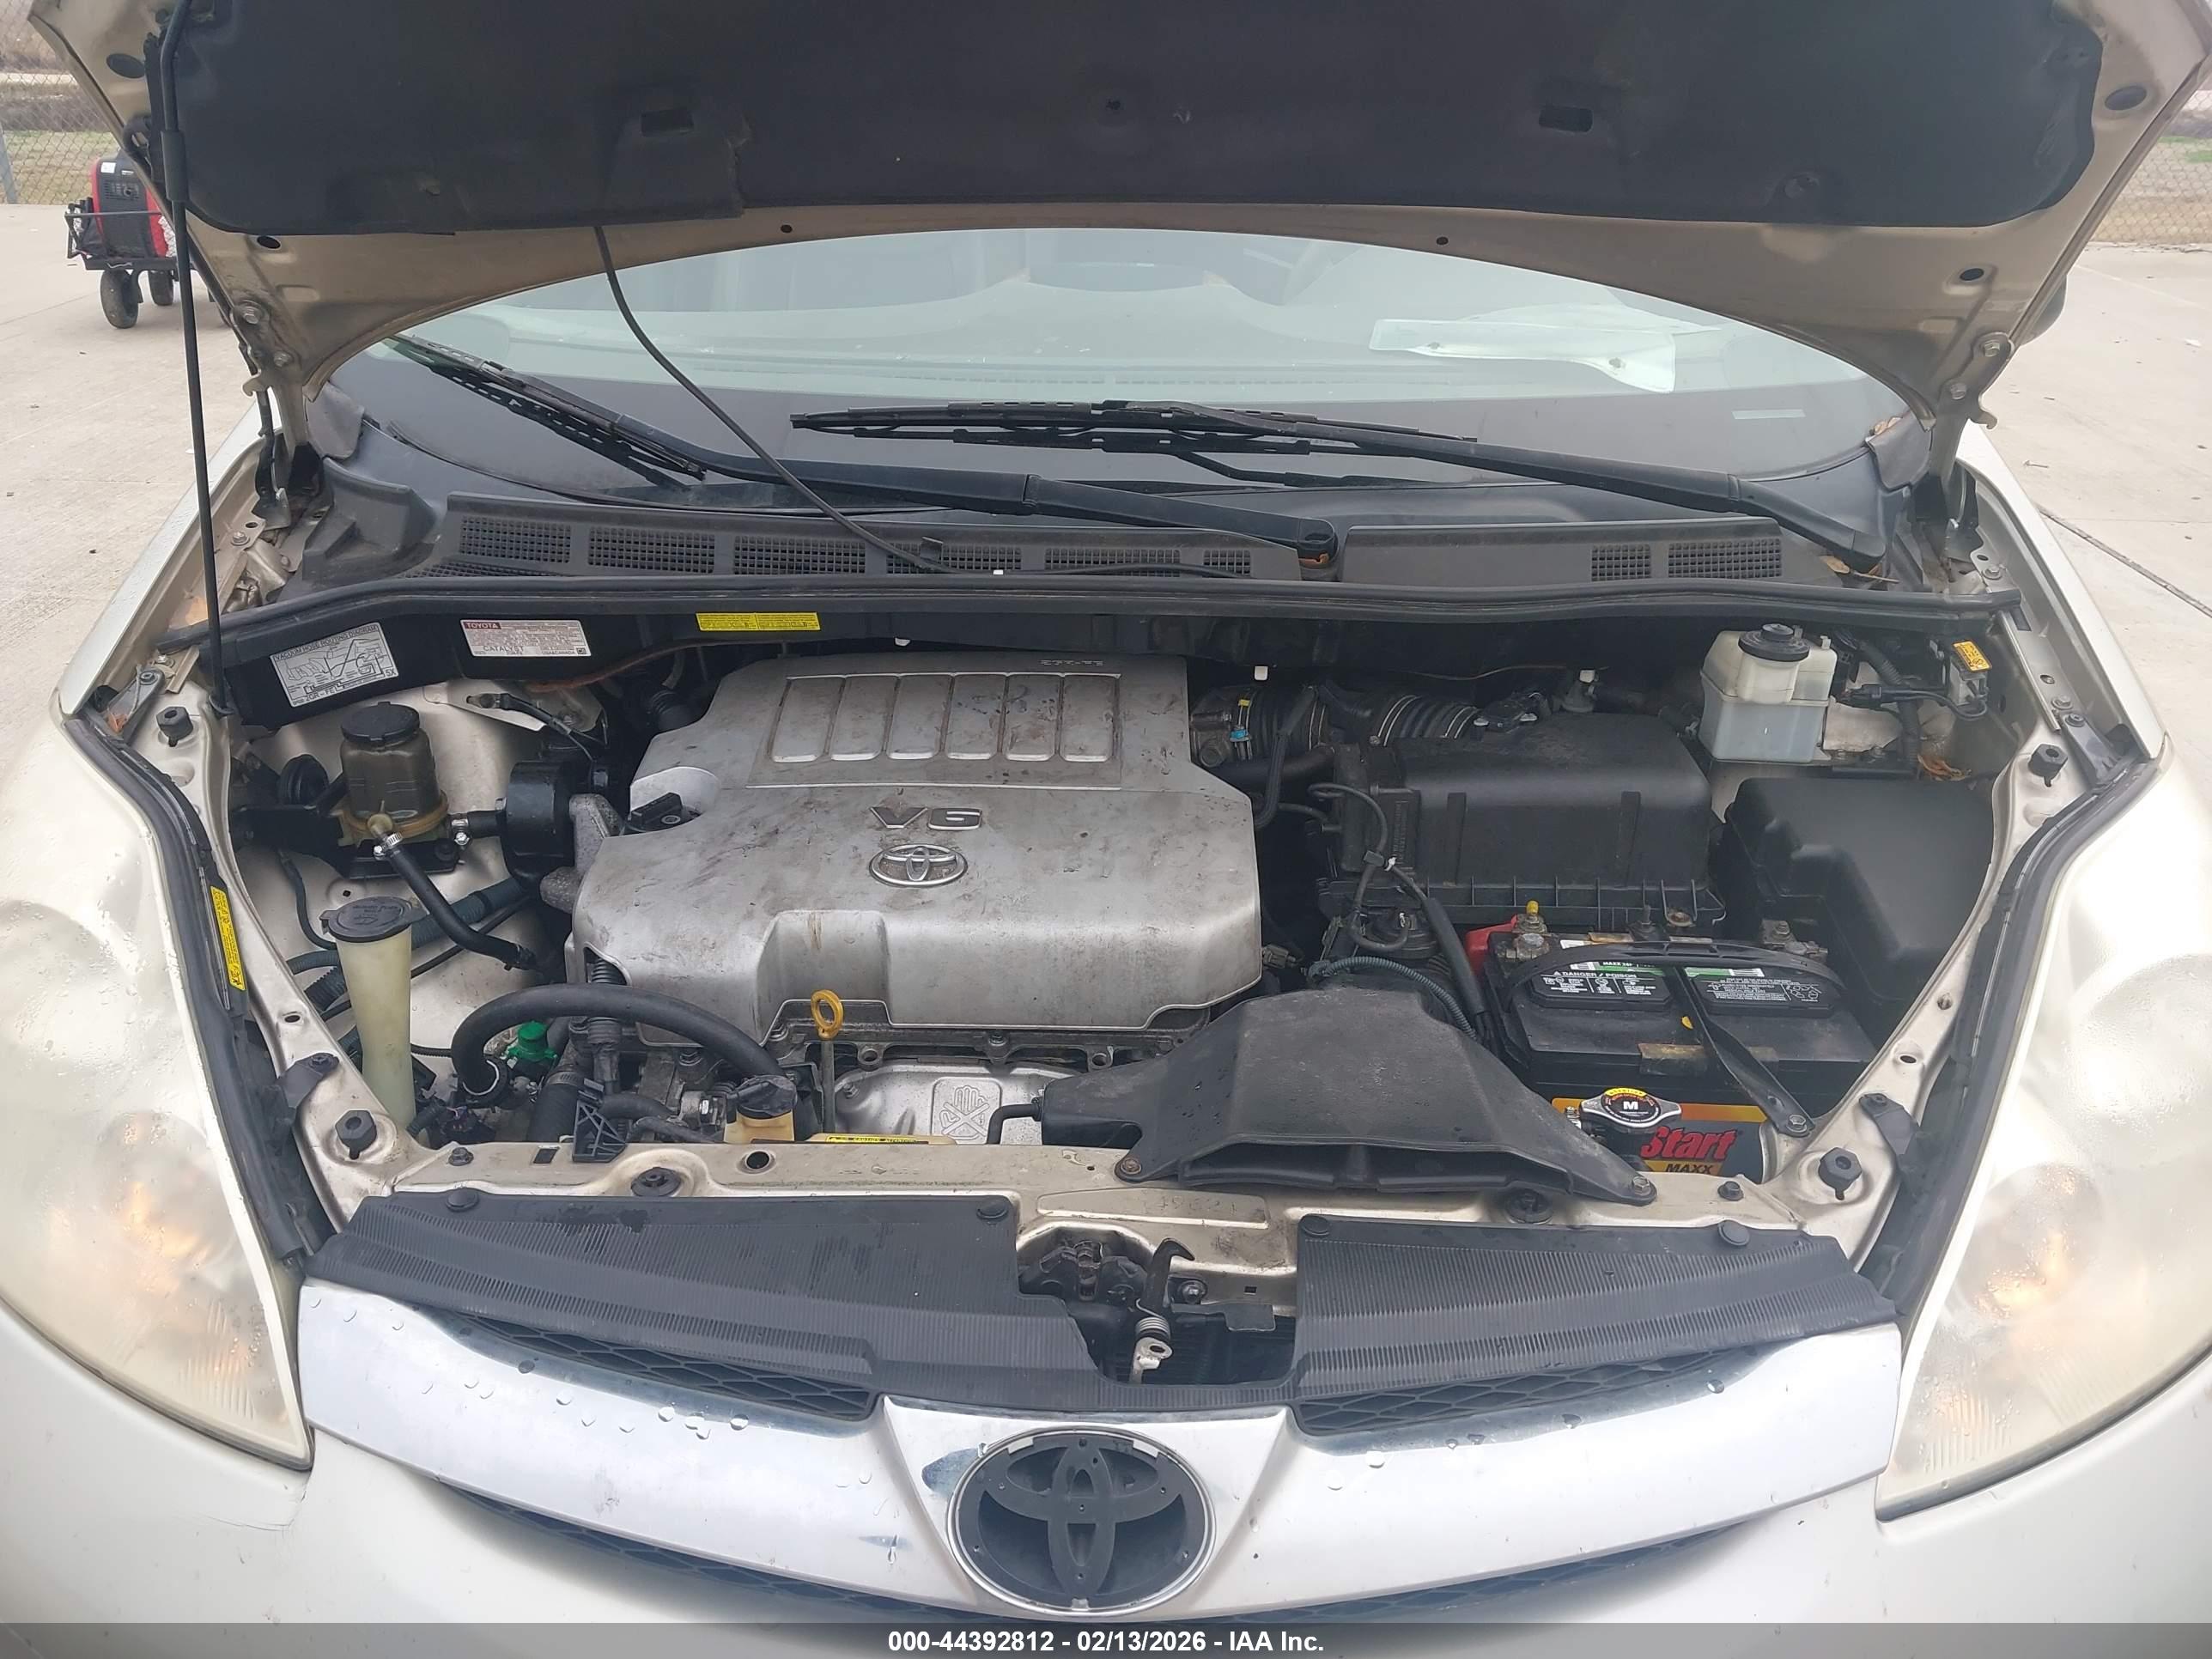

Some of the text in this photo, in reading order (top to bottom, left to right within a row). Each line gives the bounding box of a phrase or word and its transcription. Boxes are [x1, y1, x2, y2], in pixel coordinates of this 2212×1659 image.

[275, 624, 378, 660] VACUUM HOSE ROUTING DIAGRAM
[869, 806, 982, 831] V6
[1623, 1101, 1638, 1109] M
[1639, 1126, 1738, 1160] Start
[1666, 1164, 1713, 1174] MAXX
